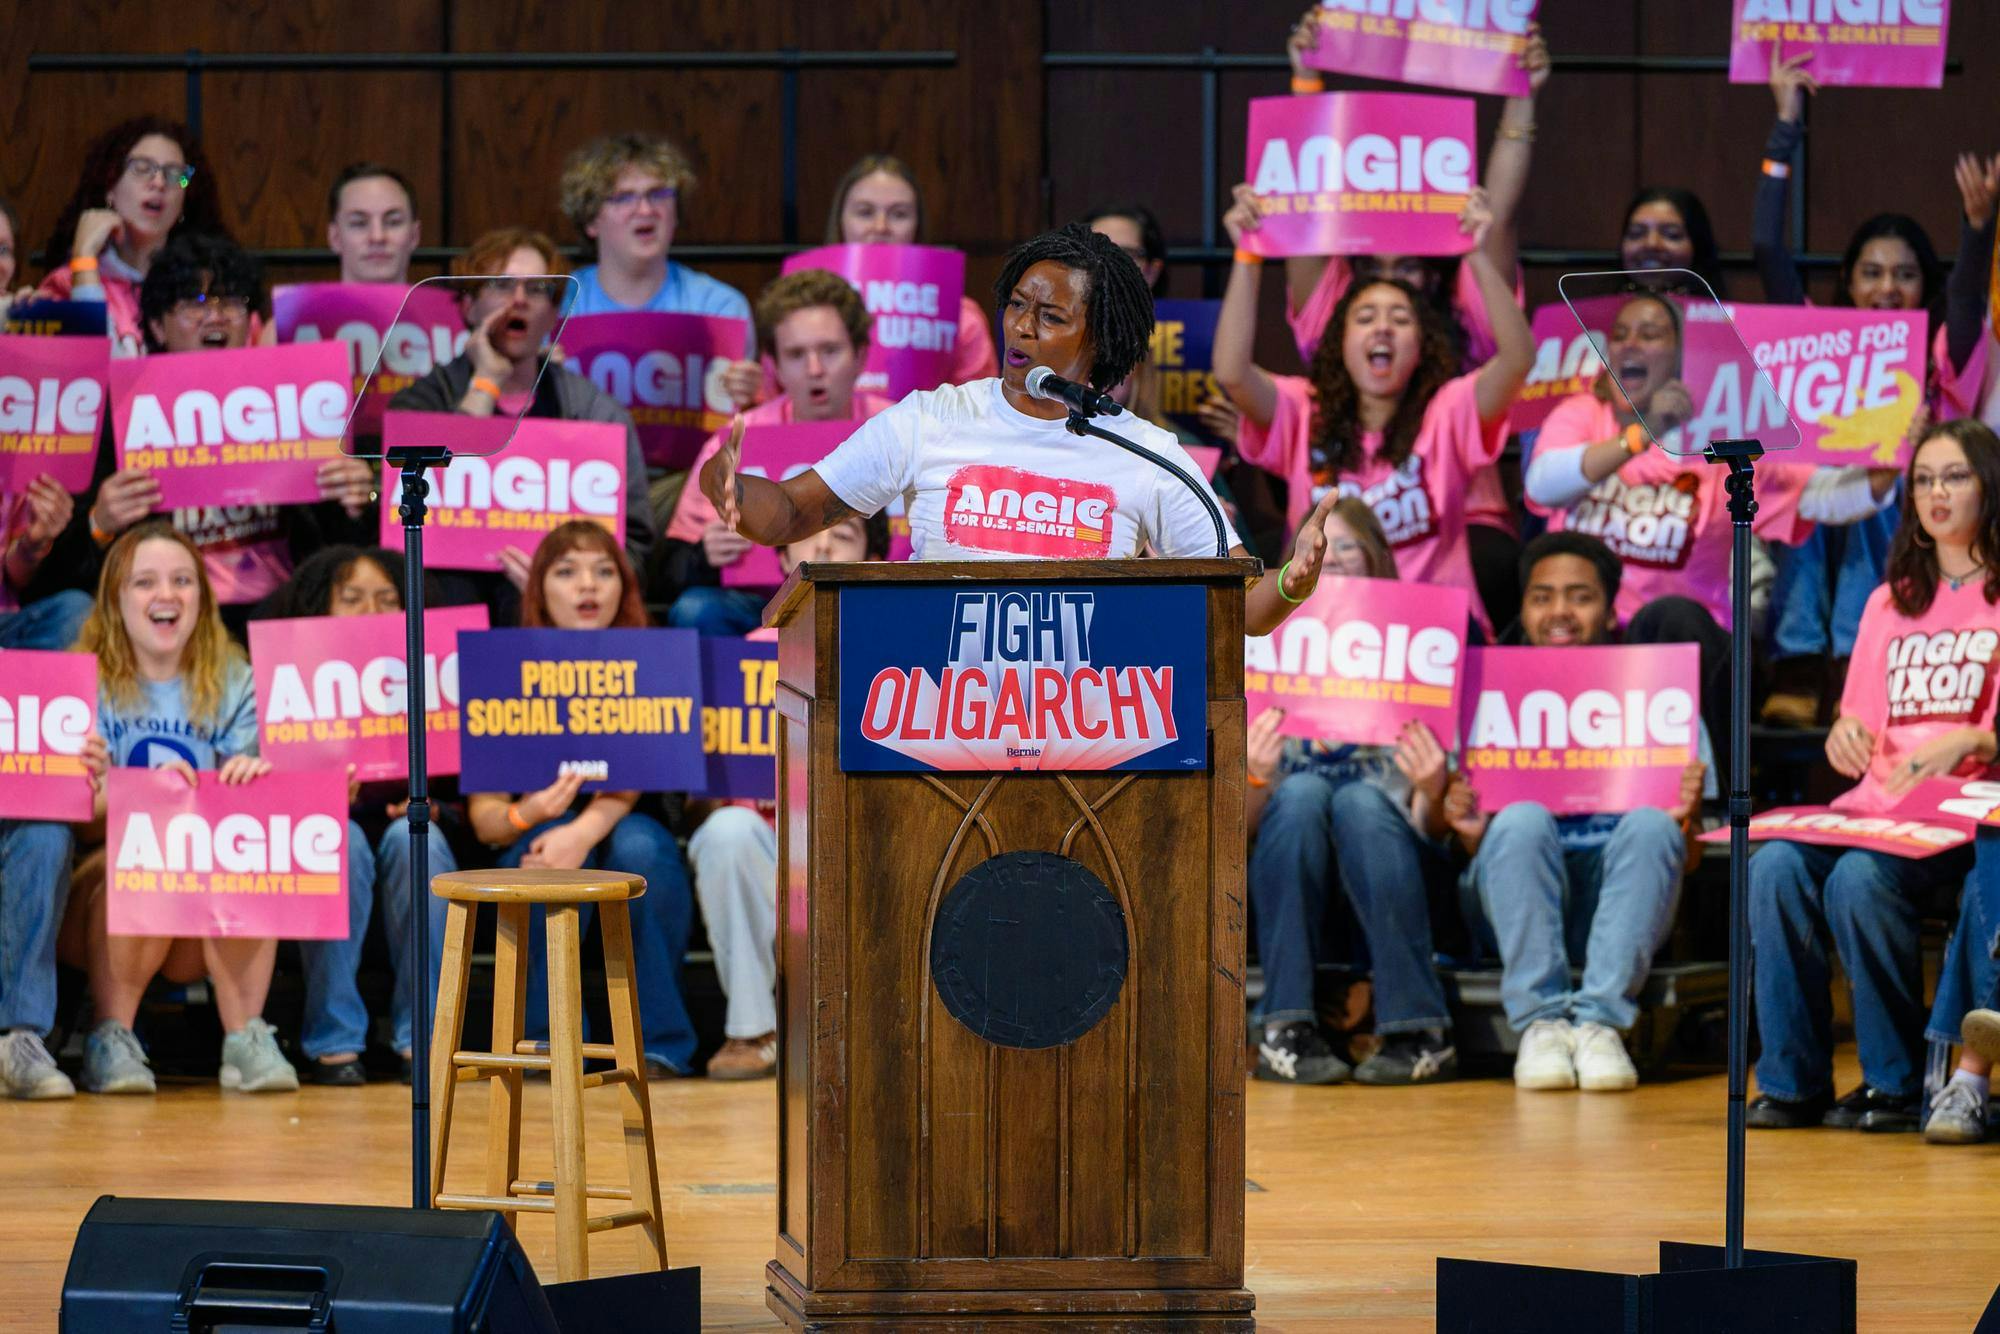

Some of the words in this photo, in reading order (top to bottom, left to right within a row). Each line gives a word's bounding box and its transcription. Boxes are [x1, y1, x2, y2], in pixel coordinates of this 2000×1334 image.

[1258, 195, 1290, 214] OR
[1754, 330, 1852, 367] GATORS
[1858, 320, 1909, 351] FOR
[1688, 348, 1908, 450] ANGIE
[125, 450, 168, 470] FOR
[174, 446, 216, 468] U.S.
[223, 441, 304, 463] SENATE
[440, 508, 481, 527] U.S.
[952, 513, 978, 527] FOR
[982, 516, 1012, 531] U.S.
[1016, 521, 1075, 537] SENATE
[948, 592, 1094, 663] FIGHT
[521, 661, 637, 697] PROTECT
[1273, 677, 1314, 697] U.S.
[1321, 679, 1406, 701] SENATE
[1887, 662, 1985, 703] IXON
[467, 699, 563, 736] SOCIAL
[568, 697, 692, 735] SECURITY
[861, 666, 1178, 741] OLIGARCHY
[266, 722, 308, 744] FOR
[313, 719, 356, 742] U.S.
[361, 711, 446, 737] SENTE
[1007, 747, 1040, 757] Bernie
[1516, 749, 1558, 768] U.S.
[1564, 748, 1649, 769] SENATE
[116, 873, 155, 892] FOR
[163, 874, 205, 893] U.S.
[211, 874, 295, 895] SENATE
